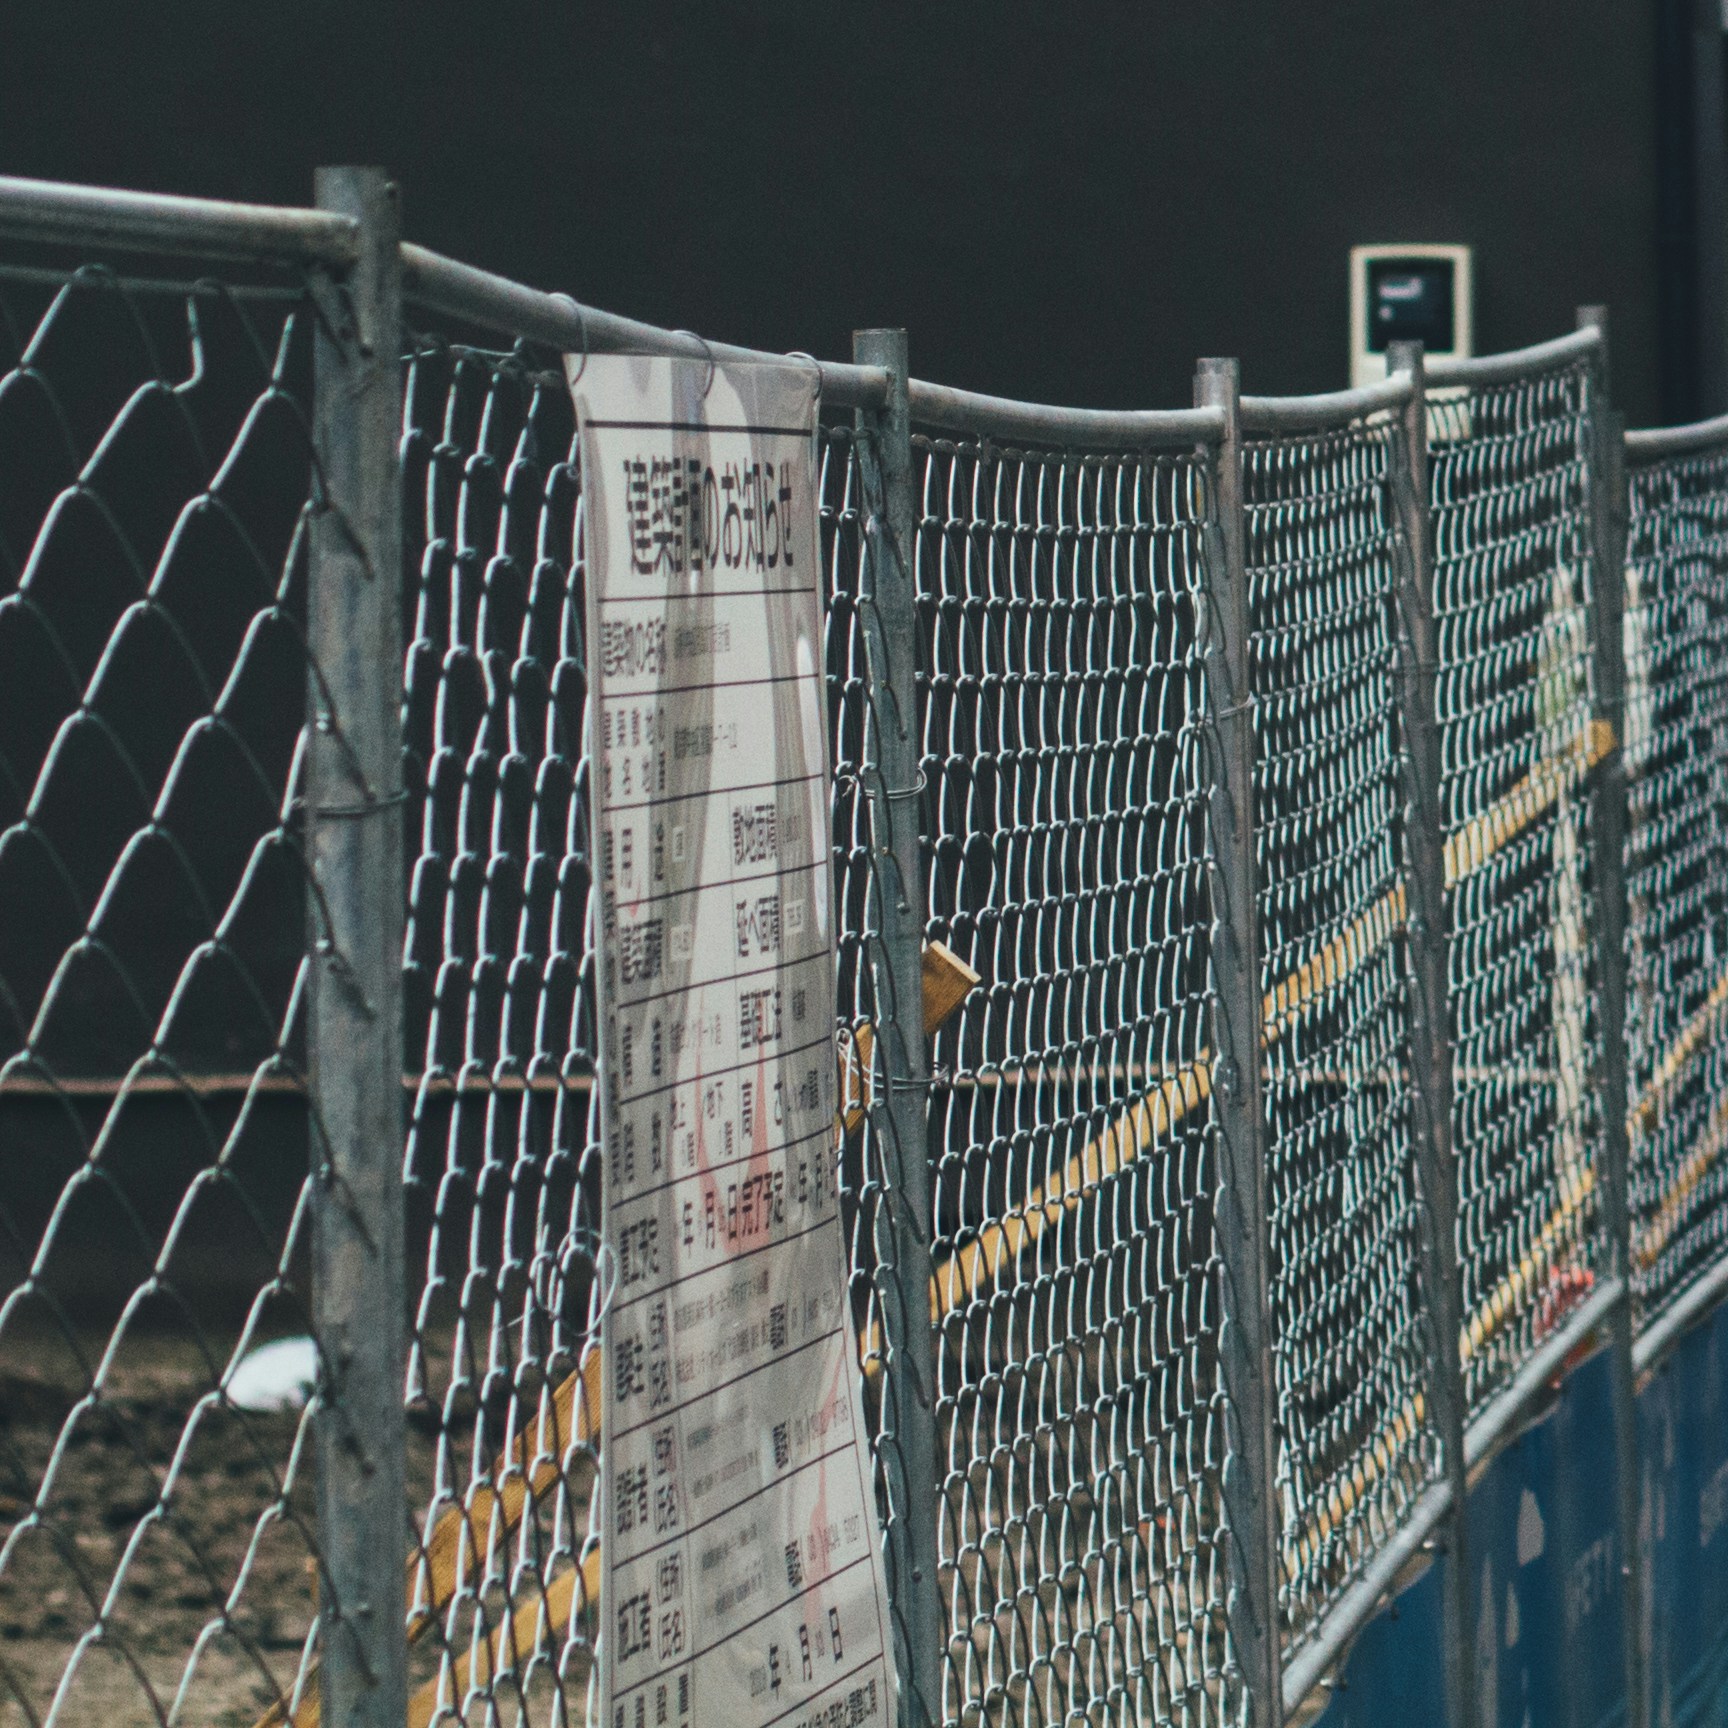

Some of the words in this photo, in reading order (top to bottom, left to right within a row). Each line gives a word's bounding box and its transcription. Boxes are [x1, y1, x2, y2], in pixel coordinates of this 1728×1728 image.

[623, 453, 795, 578] 建築計画のお知らせ
[741, 1169, 785, 1238] 完了予定
[769, 1642, 782, 1701] 年
[798, 1622, 814, 1683] 月
[827, 1605, 844, 1663] 日
